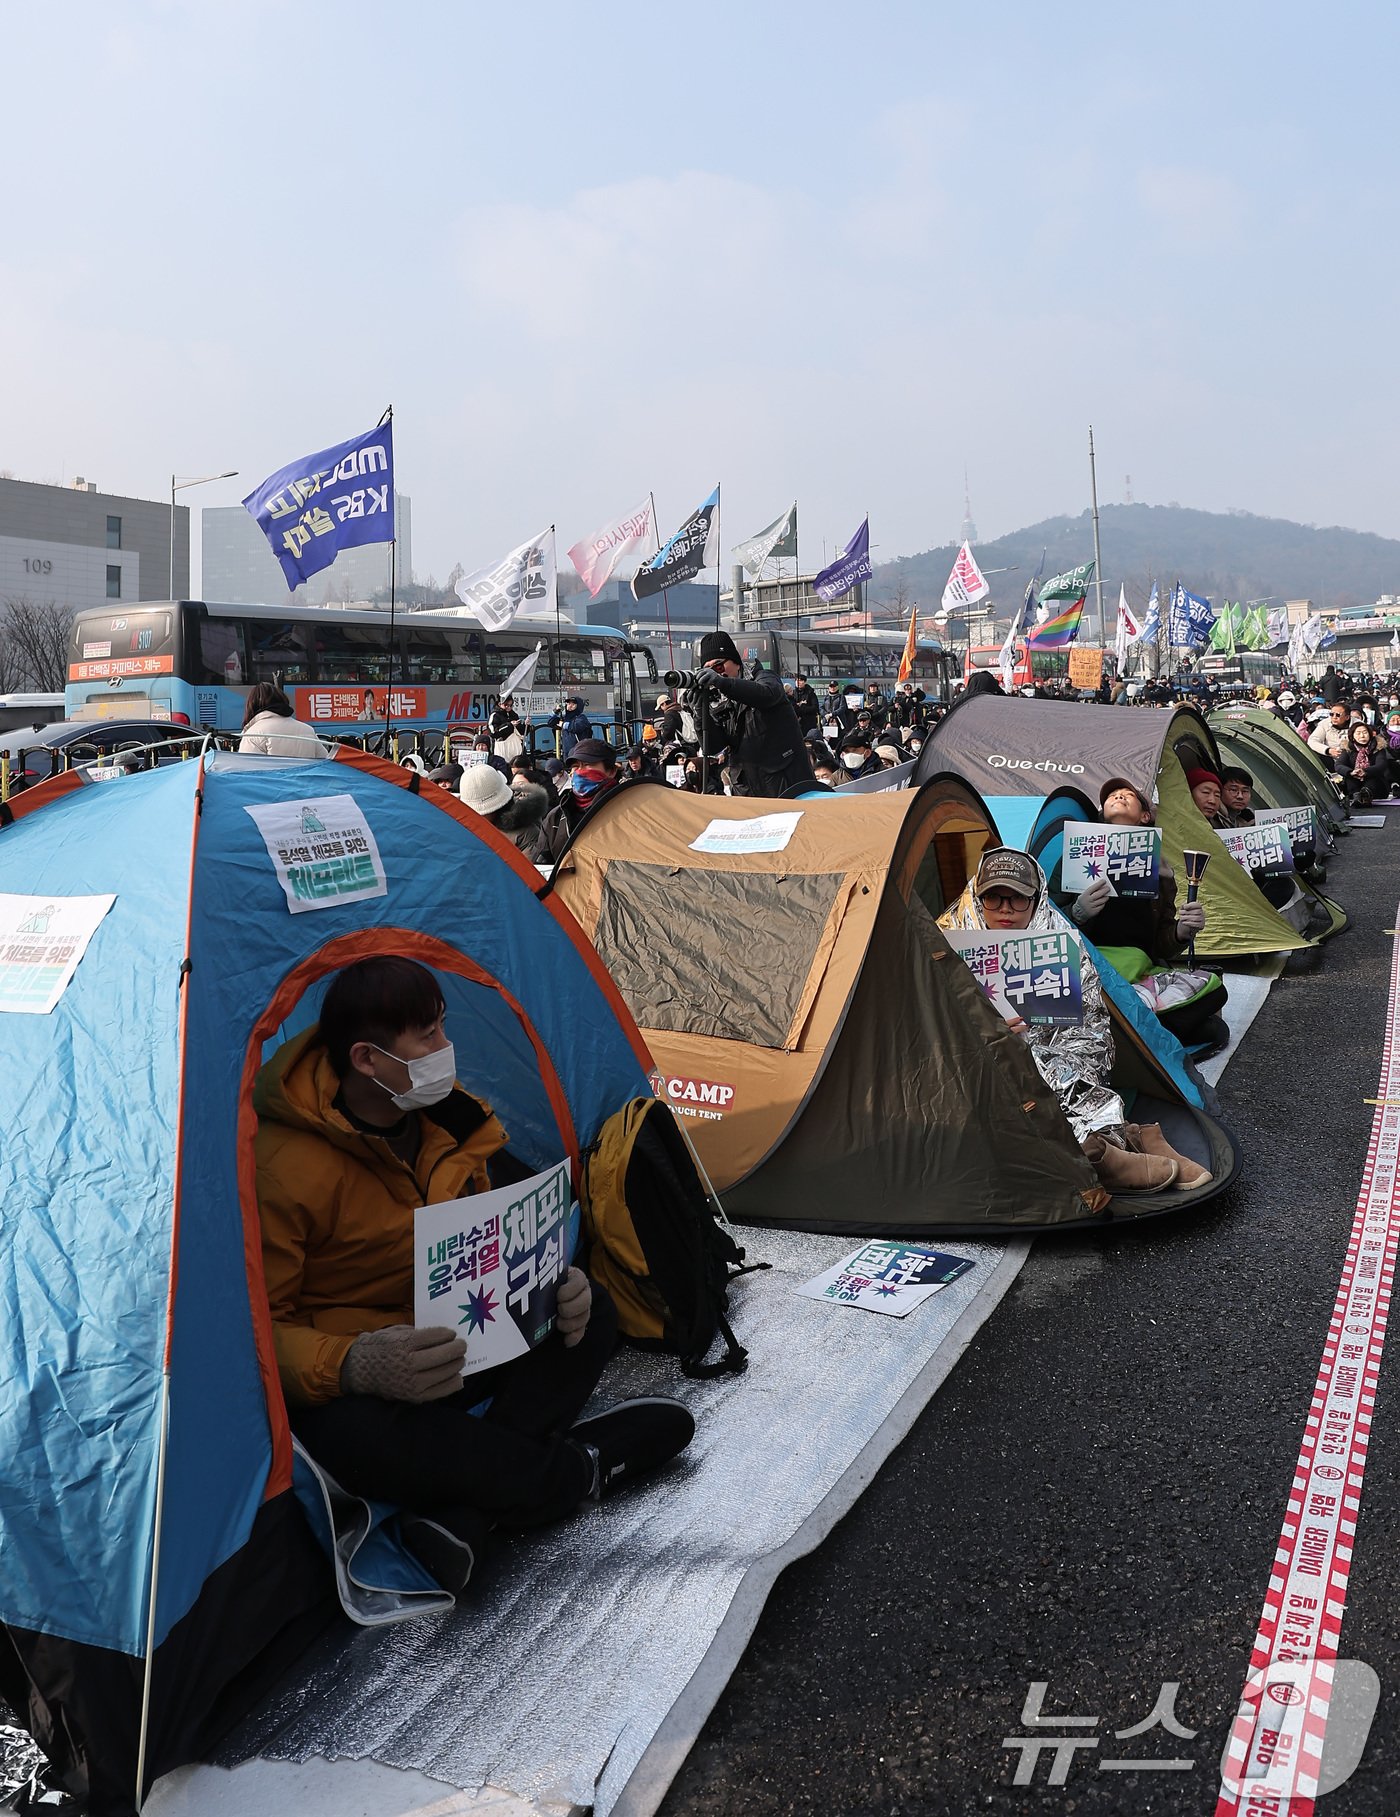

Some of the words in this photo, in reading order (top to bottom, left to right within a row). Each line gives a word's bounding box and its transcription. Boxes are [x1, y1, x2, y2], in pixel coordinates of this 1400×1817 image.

[23, 559, 52, 575] 109
[89, 663, 110, 676] 단백질
[111, 661, 142, 674] 커피믹스
[144, 659, 161, 671] 제누
[309, 694, 332, 718] 1등
[333, 693, 359, 706] 단백질
[385, 693, 416, 715] 제누
[333, 707, 360, 718] 커피믹스
[987, 754, 1085, 774] Quechua
[1285, 808, 1312, 829] 체포!
[1069, 834, 1106, 846] 내란수괴
[1108, 831, 1155, 856] 체포!
[1245, 826, 1280, 850] 해체
[278, 846, 313, 865] 윤석열
[312, 841, 346, 860] 체포를
[345, 837, 369, 854] 위한
[1069, 844, 1105, 859] 윤석열
[1248, 846, 1283, 869] 하라
[287, 854, 379, 900] 체포텐트
[1108, 855, 1153, 881] 구속!
[2, 945, 48, 963] 체포를
[45, 945, 76, 964] 위한
[1003, 934, 1068, 971] 체포!
[1006, 967, 1071, 1005] 구속!
[668, 1079, 734, 1105] CAMP
[698, 1110, 723, 1121] TENT
[506, 1170, 565, 1259] 체포!
[1369, 1199, 1388, 1222] 안전제일
[428, 1214, 500, 1266] 내란수괴
[1363, 1239, 1382, 1252] 위험
[428, 1239, 500, 1300] 윤석열
[508, 1224, 565, 1315] 구속!
[846, 1245, 900, 1279] 체포!
[884, 1251, 936, 1285] 구속!
[1358, 1255, 1378, 1279] DANGER
[822, 1274, 854, 1298] 내란수괴
[838, 1277, 872, 1301] 윤석열
[1350, 1286, 1373, 1318] 안전제일
[1341, 1344, 1364, 1360] 위험
[1334, 1366, 1358, 1399] DANGER
[1321, 1409, 1351, 1456] 안전제일
[1308, 1493, 1337, 1518] 위험
[1297, 1526, 1329, 1577] DANGER
[1277, 1594, 1318, 1667] 안전제일
[1256, 1728, 1293, 1768] 위험
